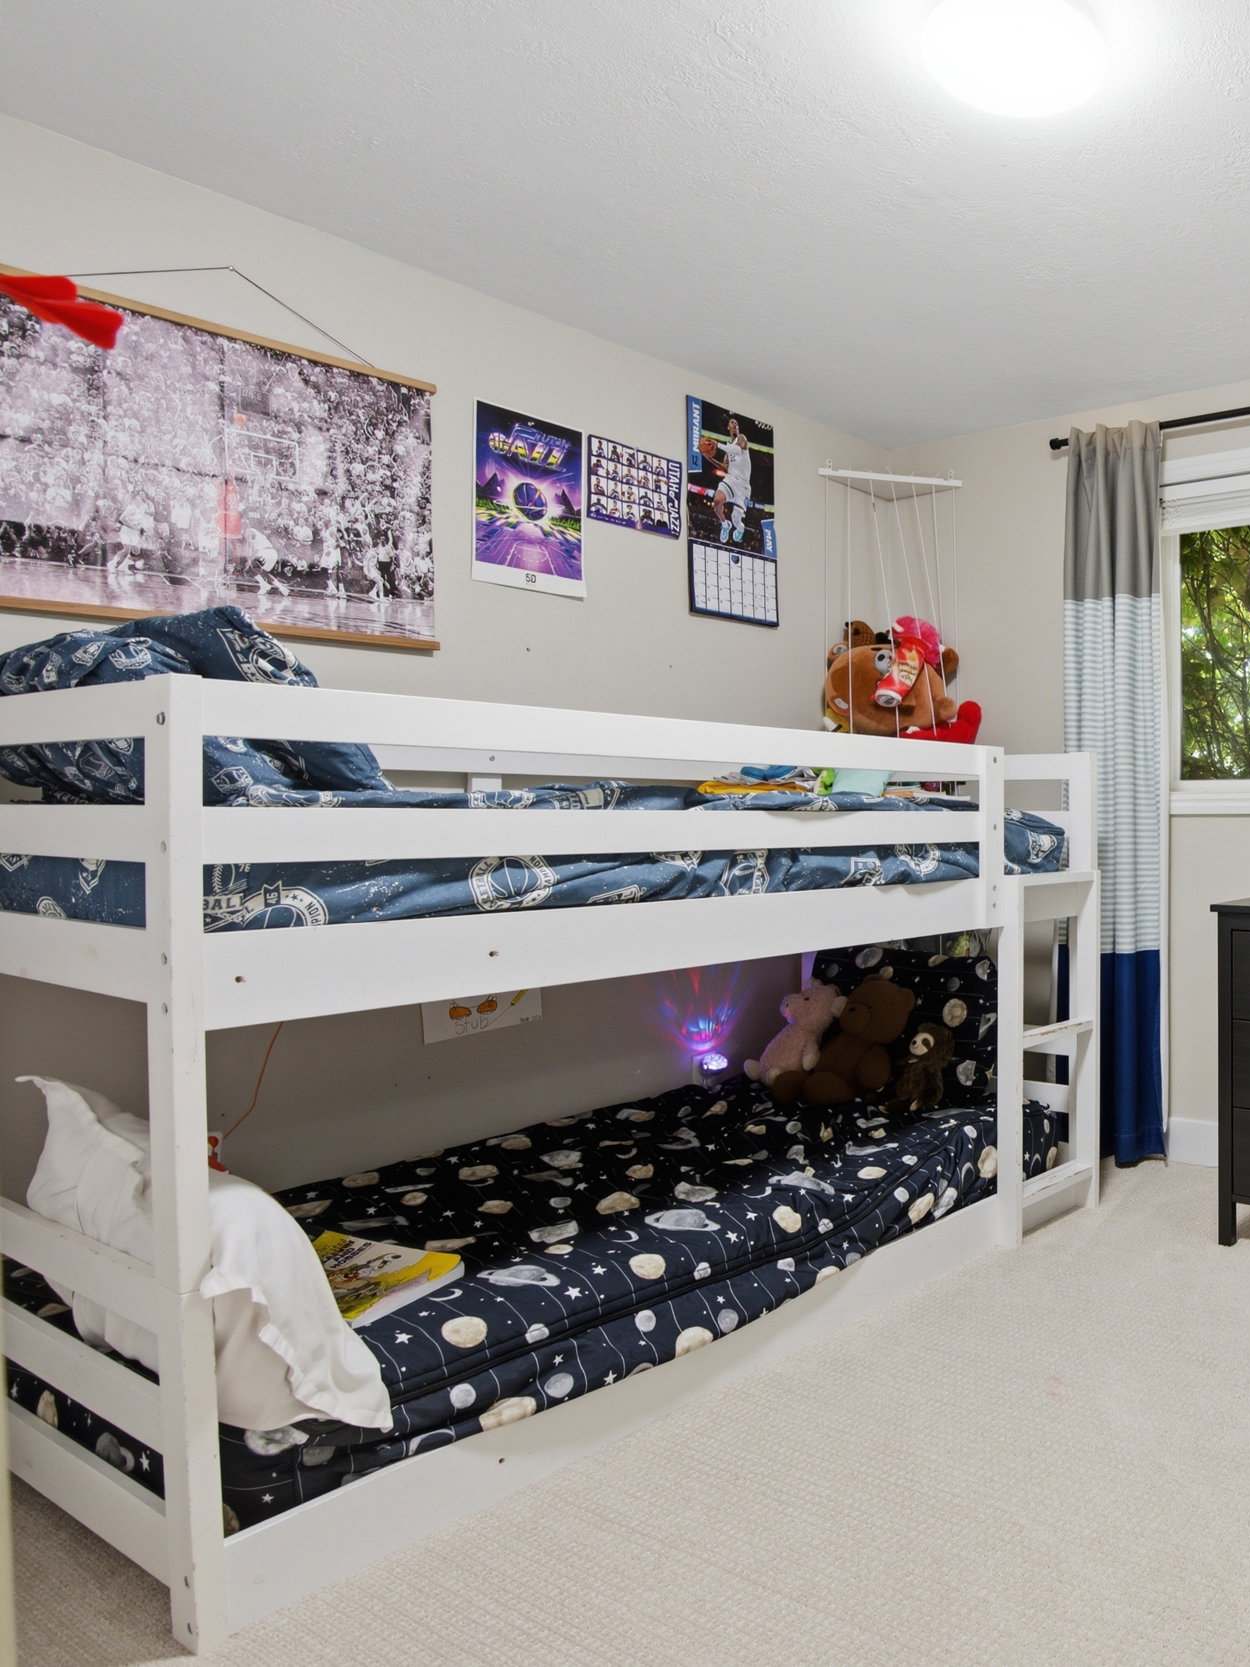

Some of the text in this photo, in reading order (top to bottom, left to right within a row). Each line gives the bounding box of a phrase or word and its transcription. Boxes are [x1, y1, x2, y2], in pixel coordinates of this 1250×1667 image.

[668, 461, 680, 533] UTAH JAZZ
[525, 572, 537, 584] 50
